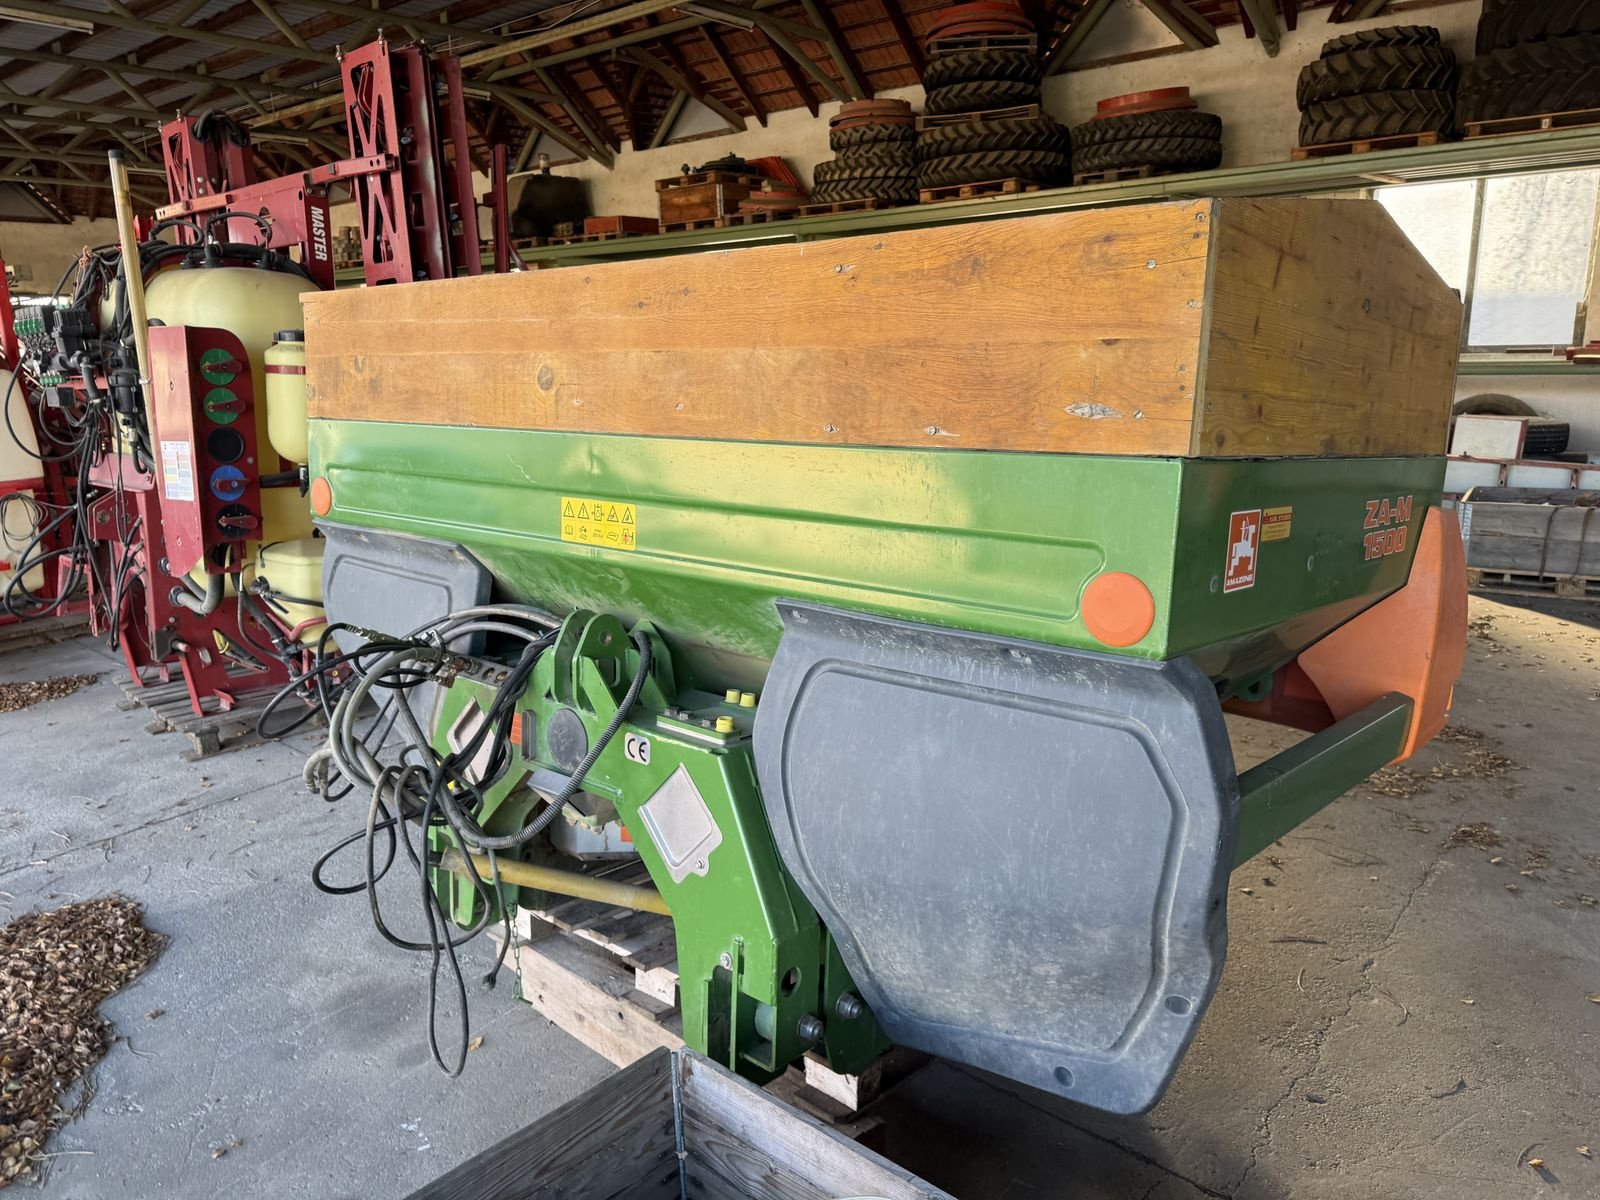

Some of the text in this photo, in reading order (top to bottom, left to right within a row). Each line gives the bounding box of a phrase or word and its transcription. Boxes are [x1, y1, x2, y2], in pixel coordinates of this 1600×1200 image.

[311, 206, 328, 261] MASTER
[1364, 495, 1413, 529] ZA-M
[1364, 526, 1408, 560] 1500
[1226, 573, 1254, 586] AMAZONE
[627, 737, 647, 762] CE
